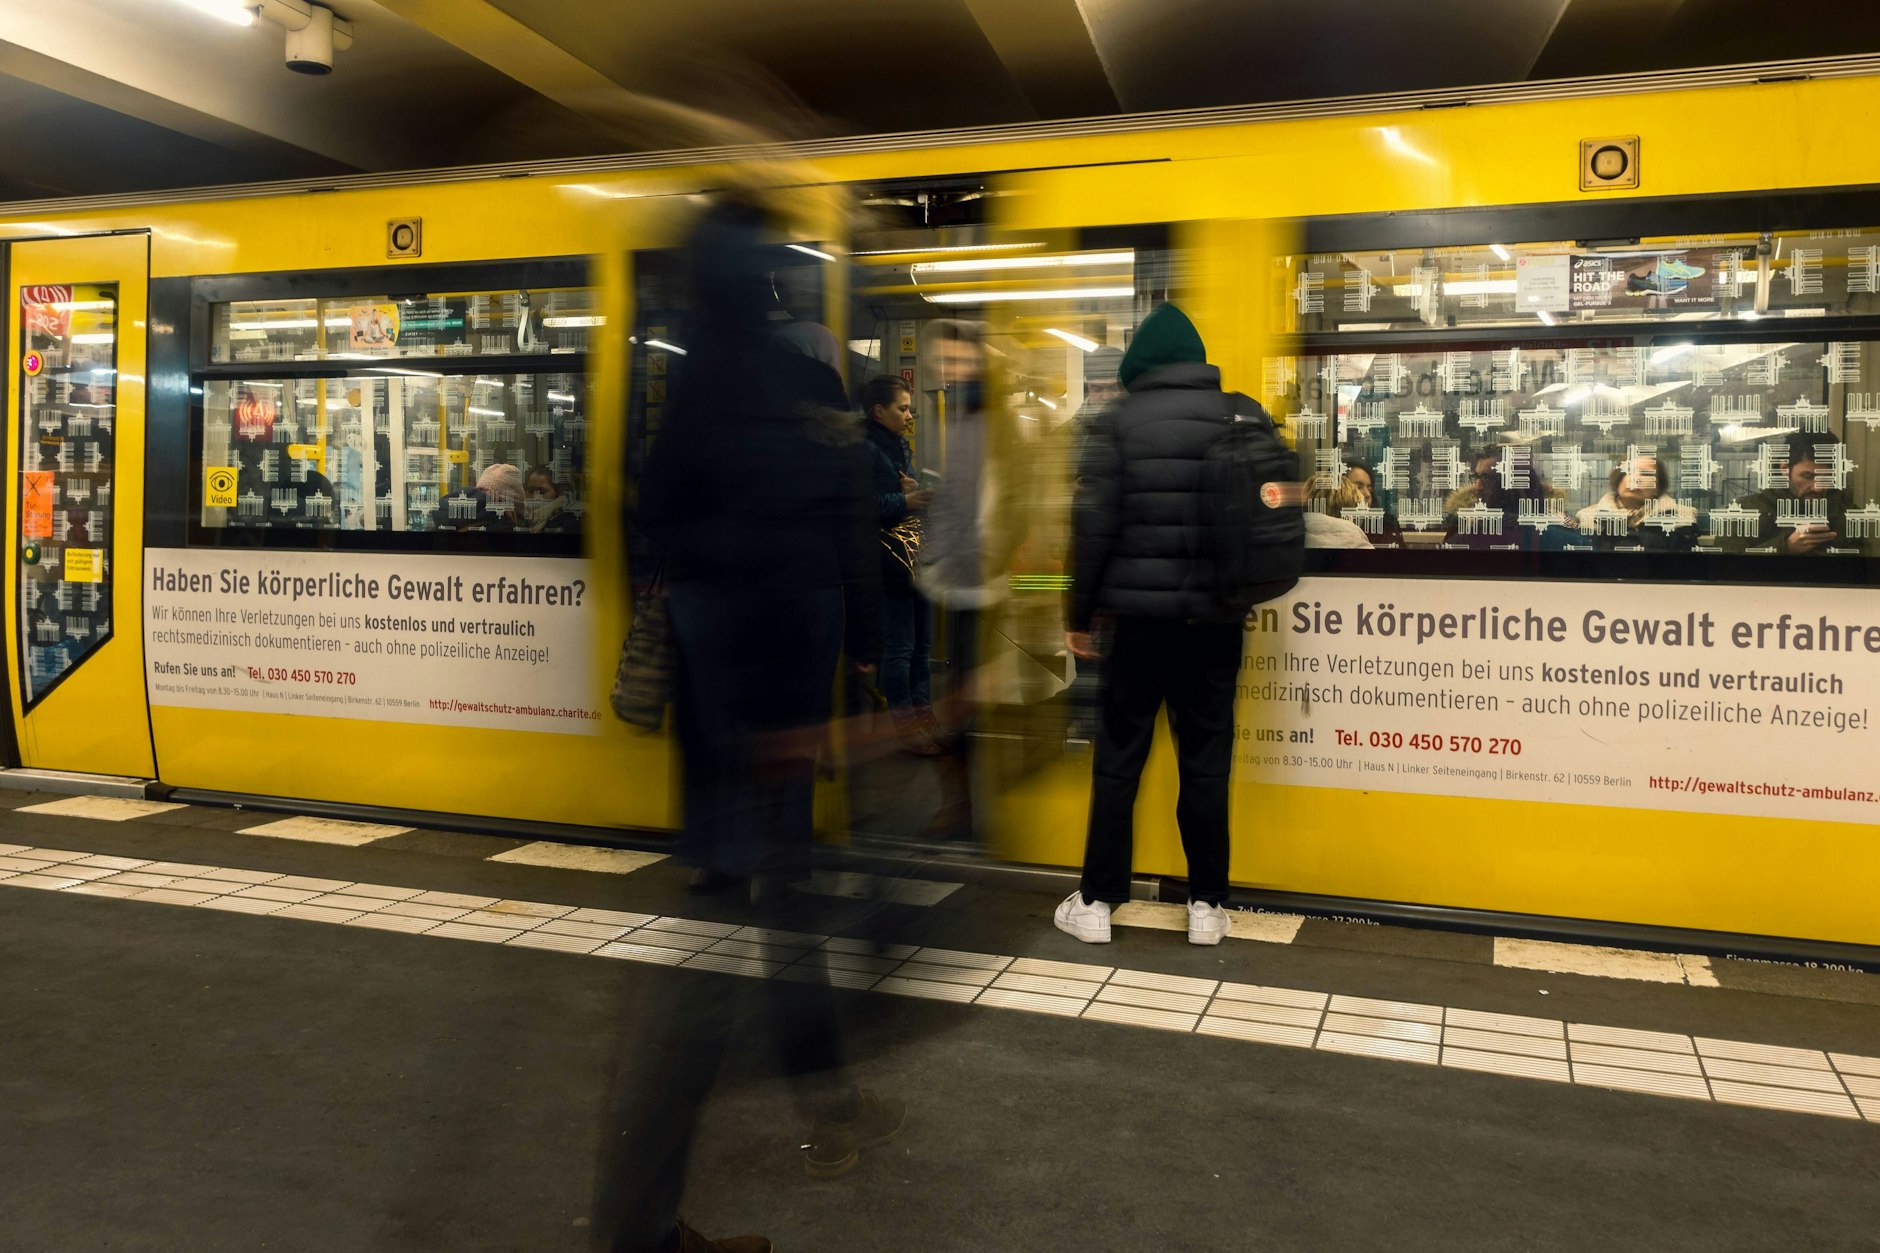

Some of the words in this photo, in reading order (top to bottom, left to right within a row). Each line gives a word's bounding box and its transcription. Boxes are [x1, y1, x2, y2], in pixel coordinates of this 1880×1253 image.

[1581, 258, 1602, 268] asics
[1573, 282, 1611, 293] ROAD
[1574, 271, 1596, 283] HIT
[1599, 270, 1625, 282] THE
[210, 494, 232, 504] Video
[153, 567, 212, 592] Haben
[220, 568, 250, 594] Sie
[258, 570, 379, 601] körperliche
[388, 574, 463, 602] Gewalt
[472, 576, 586, 607] erfahren?
[152, 605, 169, 621] Wir
[172, 606, 212, 622] können
[215, 608, 237, 623] Ihre
[241, 608, 315, 629] Verletzungen
[319, 612, 336, 627] bei
[340, 615, 361, 629] uns
[364, 614, 427, 632] kostenlos
[431, 617, 455, 633] und
[460, 619, 535, 637] vertraulich
[1292, 601, 1343, 635] Sie
[1357, 602, 1567, 645] körperliche
[1582, 609, 1715, 648] Gewalt
[152, 629, 251, 647] rechtsmedizinisch
[254, 632, 341, 651] dokumentieren
[354, 637, 382, 655] auch
[387, 640, 416, 656] ohne
[421, 641, 490, 659] polizeiliche
[495, 644, 549, 665] Anzeige!
[154, 661, 181, 675] Rufen
[183, 662, 198, 676] Sie
[201, 665, 218, 677] uns
[221, 665, 236, 678] an!
[248, 666, 265, 680] Tel.
[268, 668, 287, 681] 030
[291, 669, 311, 682] 450
[314, 670, 333, 684] 570
[337, 671, 356, 685] 270
[1285, 653, 1320, 673] Ihre
[1327, 654, 1454, 681] Verletzungen
[1462, 659, 1491, 680] bei
[1500, 663, 1534, 682] uns
[1542, 662, 1650, 686] kostenlos
[1659, 668, 1700, 688] und
[1709, 669, 1843, 695] vertraulich
[155, 683, 175, 694] Montag
[176, 684, 184, 693] bis
[186, 685, 205, 695] Freitag
[218, 687, 249, 697] 8.30-15.00
[250, 688, 259, 697] Uhr
[266, 689, 278, 698] Haus
[279, 690, 284, 698] N
[288, 691, 304, 700] Linker
[305, 692, 344, 704] Seiteneingang
[348, 694, 374, 704] Birkenstr.
[375, 697, 382, 705] 62
[386, 698, 402, 707] 10559
[403, 699, 420, 708] Berlin
[429, 699, 602, 721] http://gewaltschutz-ambulanz.charite.de
[1350, 686, 1498, 710] dokumentieren
[1522, 694, 1570, 715] auch
[1578, 696, 1630, 718] ohne
[1638, 699, 1762, 724] polizeiliche
[1770, 704, 1868, 733] Anzeige!
[1256, 727, 1284, 743] uns
[1289, 728, 1315, 744] an!
[1335, 729, 1364, 747] Tel.
[1369, 731, 1403, 749] 030
[1409, 733, 1443, 751] 450
[1449, 736, 1482, 753] 570
[1488, 738, 1522, 756] 270
[1263, 757, 1280, 766] von
[1283, 755, 1333, 769] 8.30-15.00
[1336, 758, 1353, 770] Uhr
[1364, 761, 1385, 772] Haus
[1387, 761, 1394, 773] N
[1402, 763, 1429, 775] Linker
[1432, 764, 1497, 780] Seiteneingang
[1505, 769, 1550, 783] Birkenstr.
[1553, 773, 1565, 783] 62
[1573, 774, 1601, 785] 10559
[1603, 775, 1632, 787] Berlin
[1649, 775, 1880, 803] http://gewaltschutz-ambulanz.
